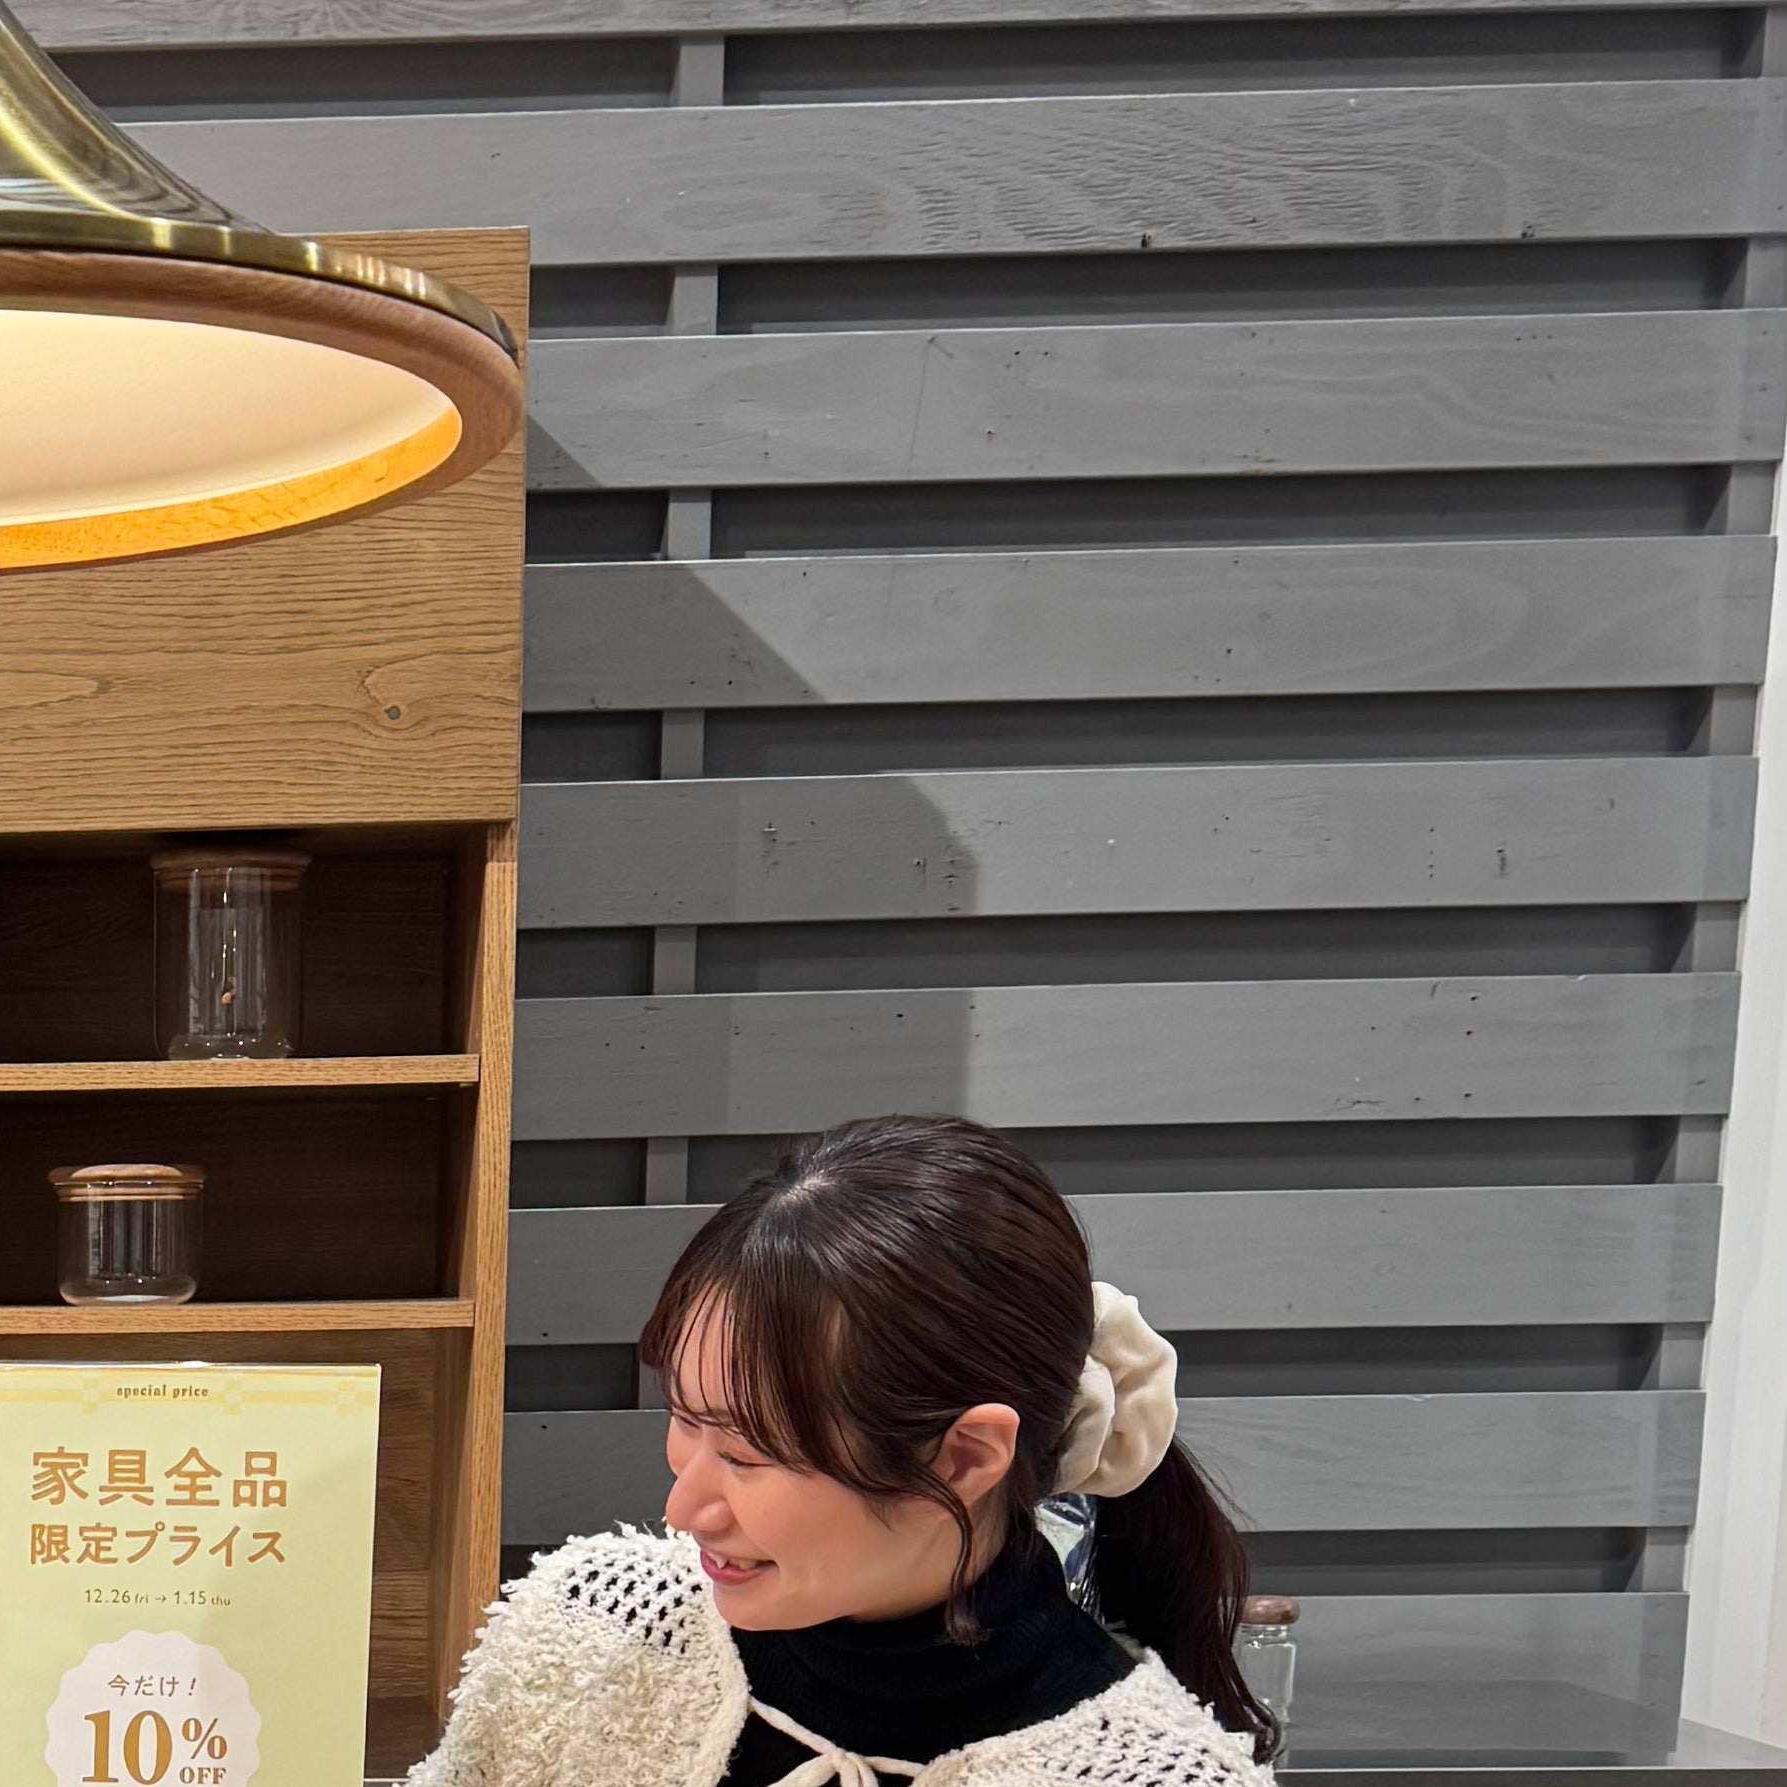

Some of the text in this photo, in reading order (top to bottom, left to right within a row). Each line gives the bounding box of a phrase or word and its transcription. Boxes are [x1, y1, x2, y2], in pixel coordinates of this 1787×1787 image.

[116, 1384, 209, 1399] special price
[31, 1446, 288, 1508] 家具全品
[30, 1520, 286, 1567] 限定プライス
[84, 1588, 131, 1604] 12.26
[173, 1590, 207, 1606] 1.15
[211, 1596, 231, 1606] thu
[108, 1674, 197, 1697] 今だけ！
[179, 1766, 227, 1785] OFF
